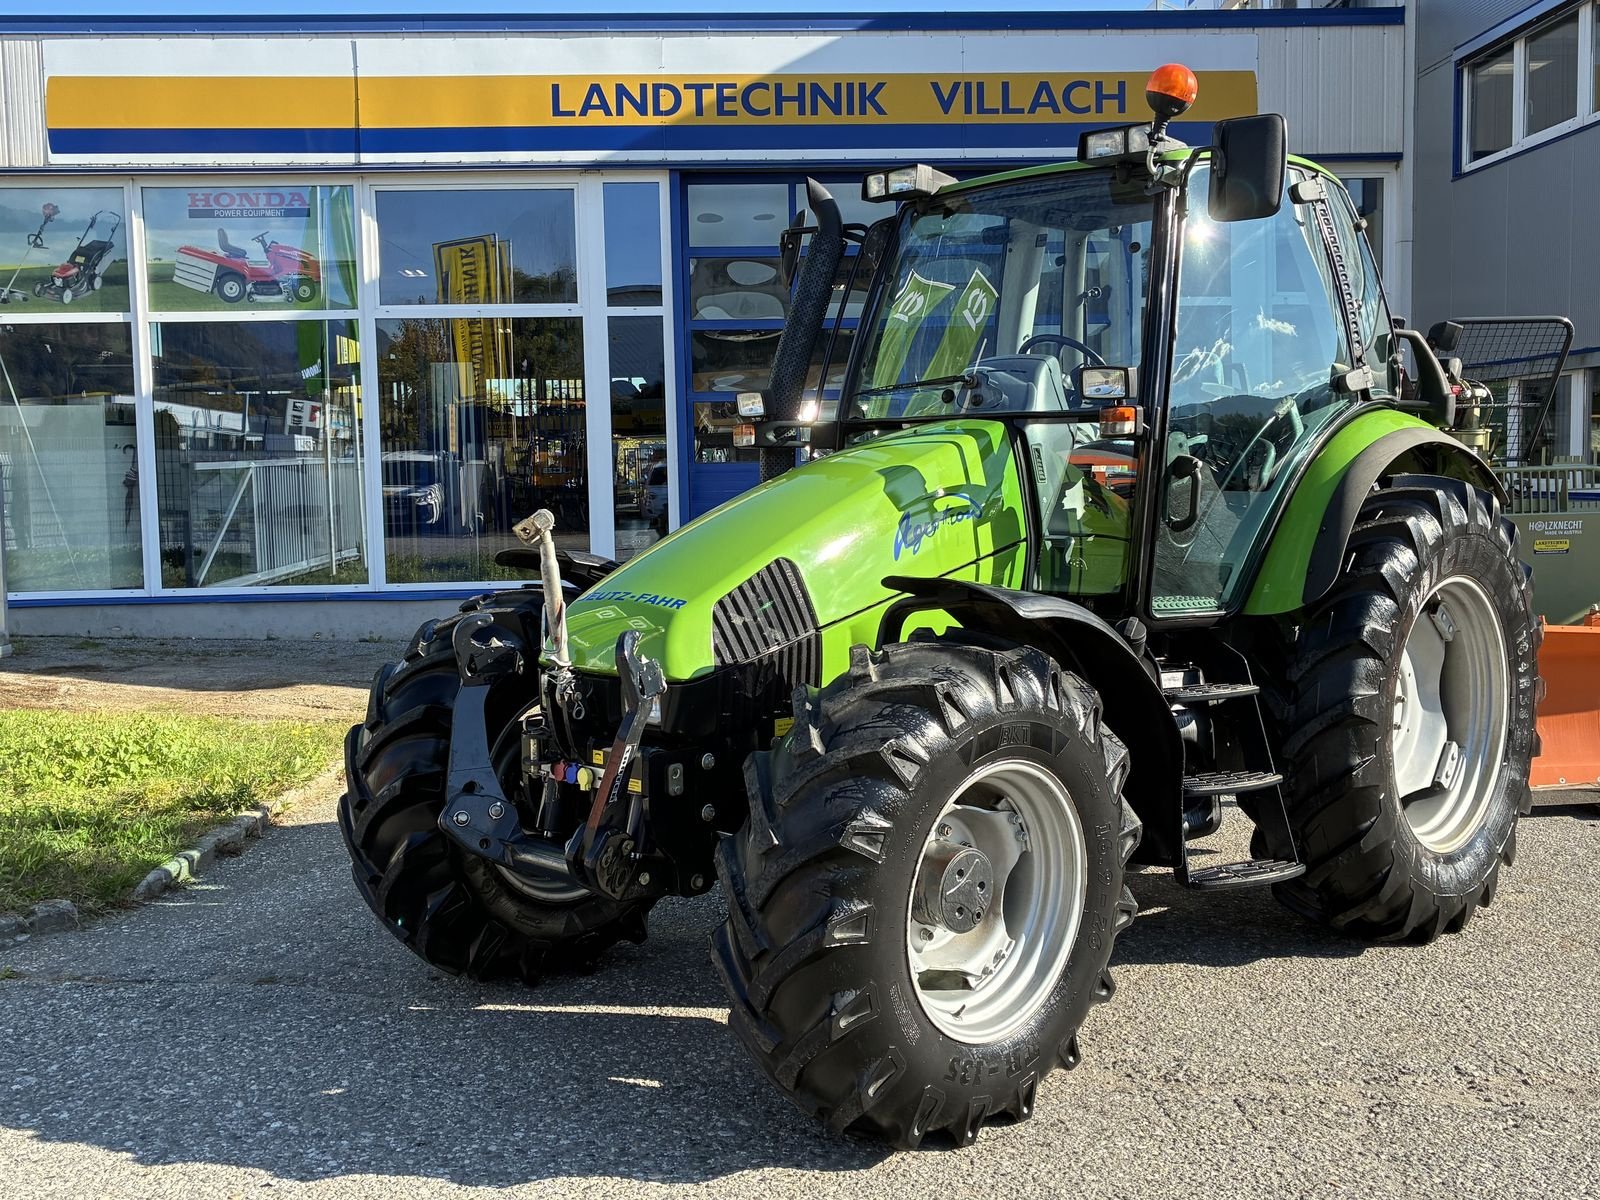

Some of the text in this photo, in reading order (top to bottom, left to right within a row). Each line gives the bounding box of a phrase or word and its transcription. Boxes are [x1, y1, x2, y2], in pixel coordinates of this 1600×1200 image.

[551, 80, 1127, 117] LANDTECHNIK VILLACH
[187, 192, 310, 208] HONDA
[243, 209, 285, 217] EQUIPMENT
[1529, 520, 1583, 531] HOLZKNECHT
[1000, 723, 1030, 747] BKT
